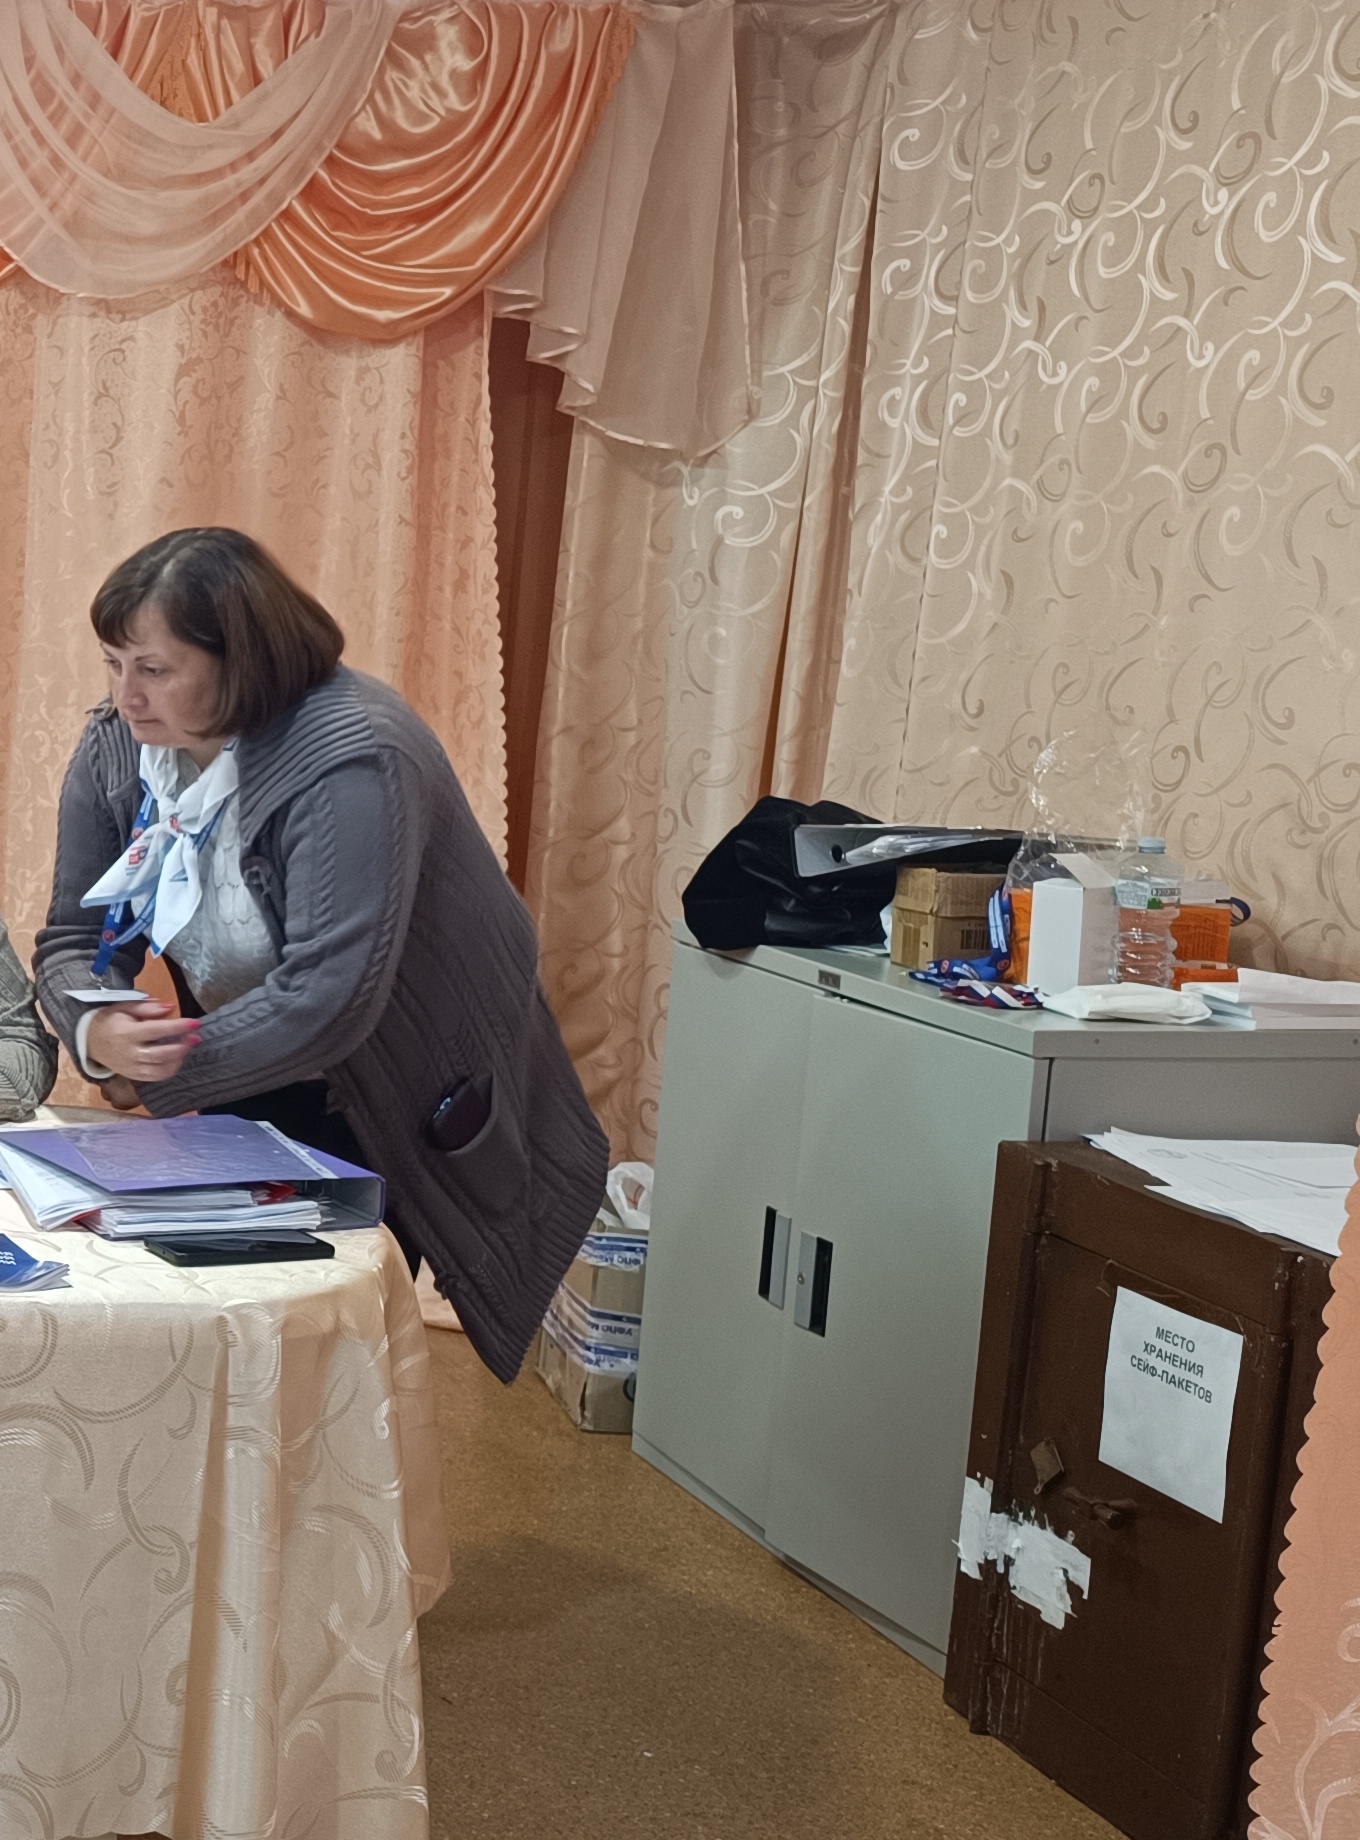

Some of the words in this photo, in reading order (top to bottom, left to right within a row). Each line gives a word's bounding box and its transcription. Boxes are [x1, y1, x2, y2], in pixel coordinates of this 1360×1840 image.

[1156, 1326, 1196, 1353] МЕСТО
[1143, 1340, 1204, 1378] ХРАНЕНИЯ
[1130, 1354, 1213, 1404] СЕЙФ-ПАКЕТОВ
